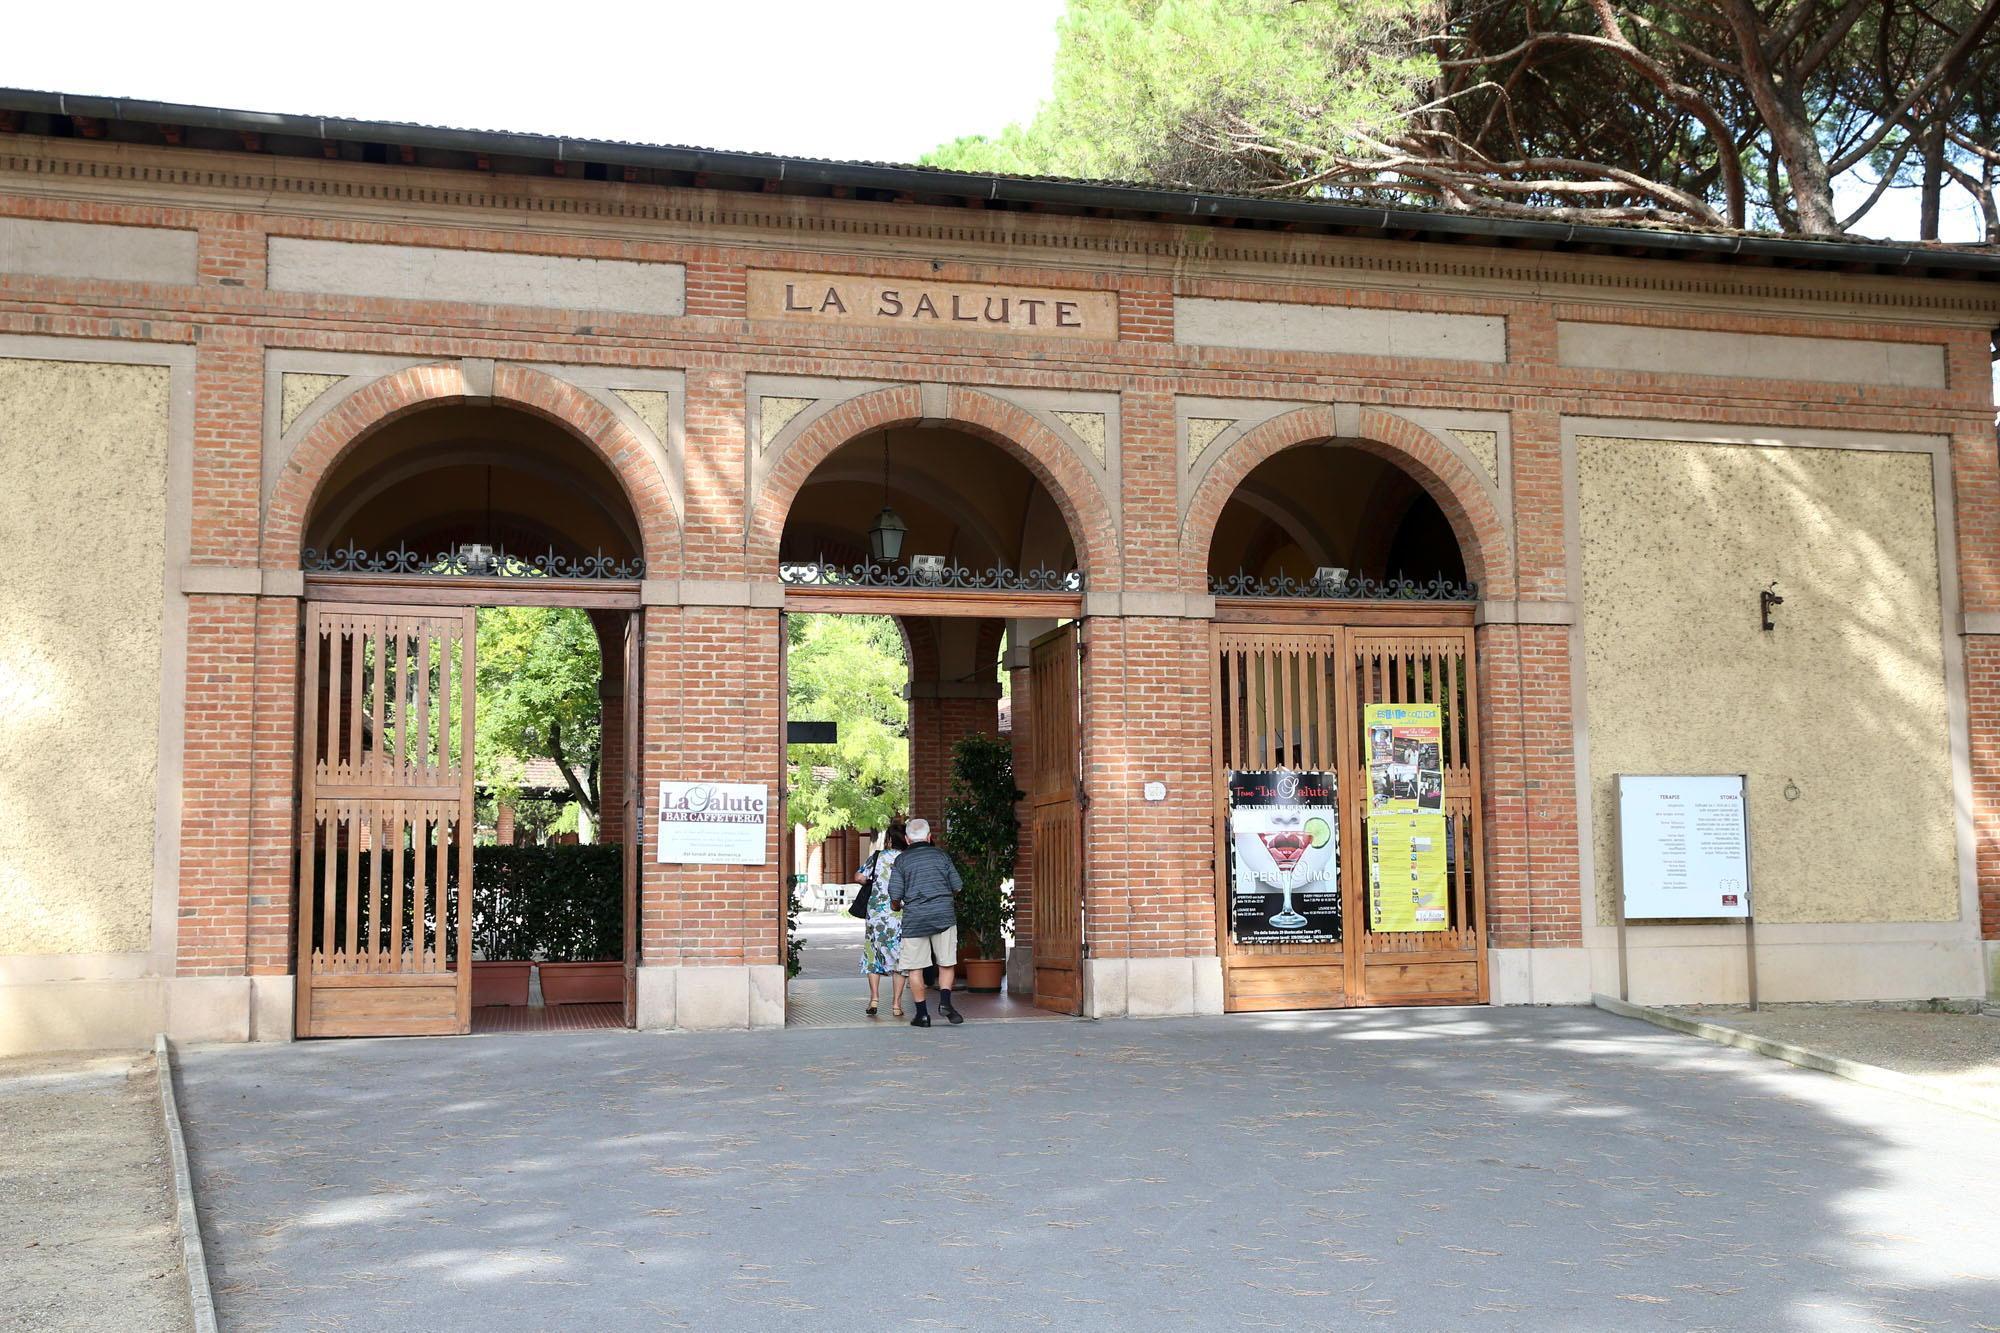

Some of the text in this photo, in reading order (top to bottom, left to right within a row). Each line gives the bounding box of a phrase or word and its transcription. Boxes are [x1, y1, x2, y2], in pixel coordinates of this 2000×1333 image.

[785, 284, 1082, 328] LA SALUTE
[663, 784, 764, 813] La Salute
[666, 811, 761, 823] BAR CAFFETTERIA
